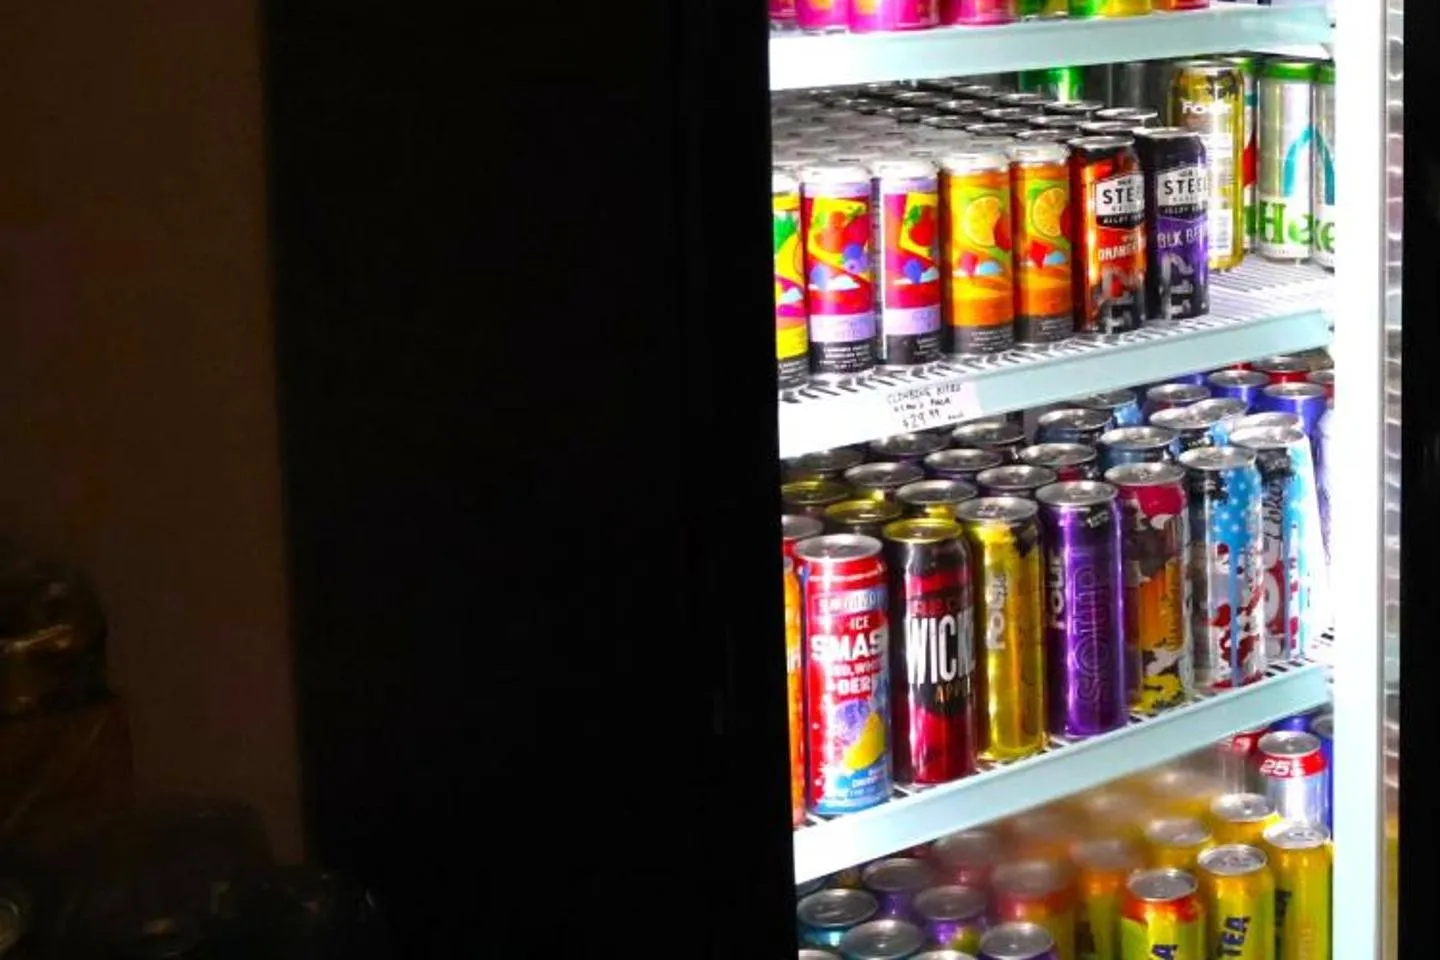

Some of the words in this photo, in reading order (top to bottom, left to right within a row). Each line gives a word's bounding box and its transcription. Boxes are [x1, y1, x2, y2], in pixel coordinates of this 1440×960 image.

[851, 615, 870, 630] ICE
[811, 628, 888, 662] SMAS
[904, 607, 976, 686] WICK
